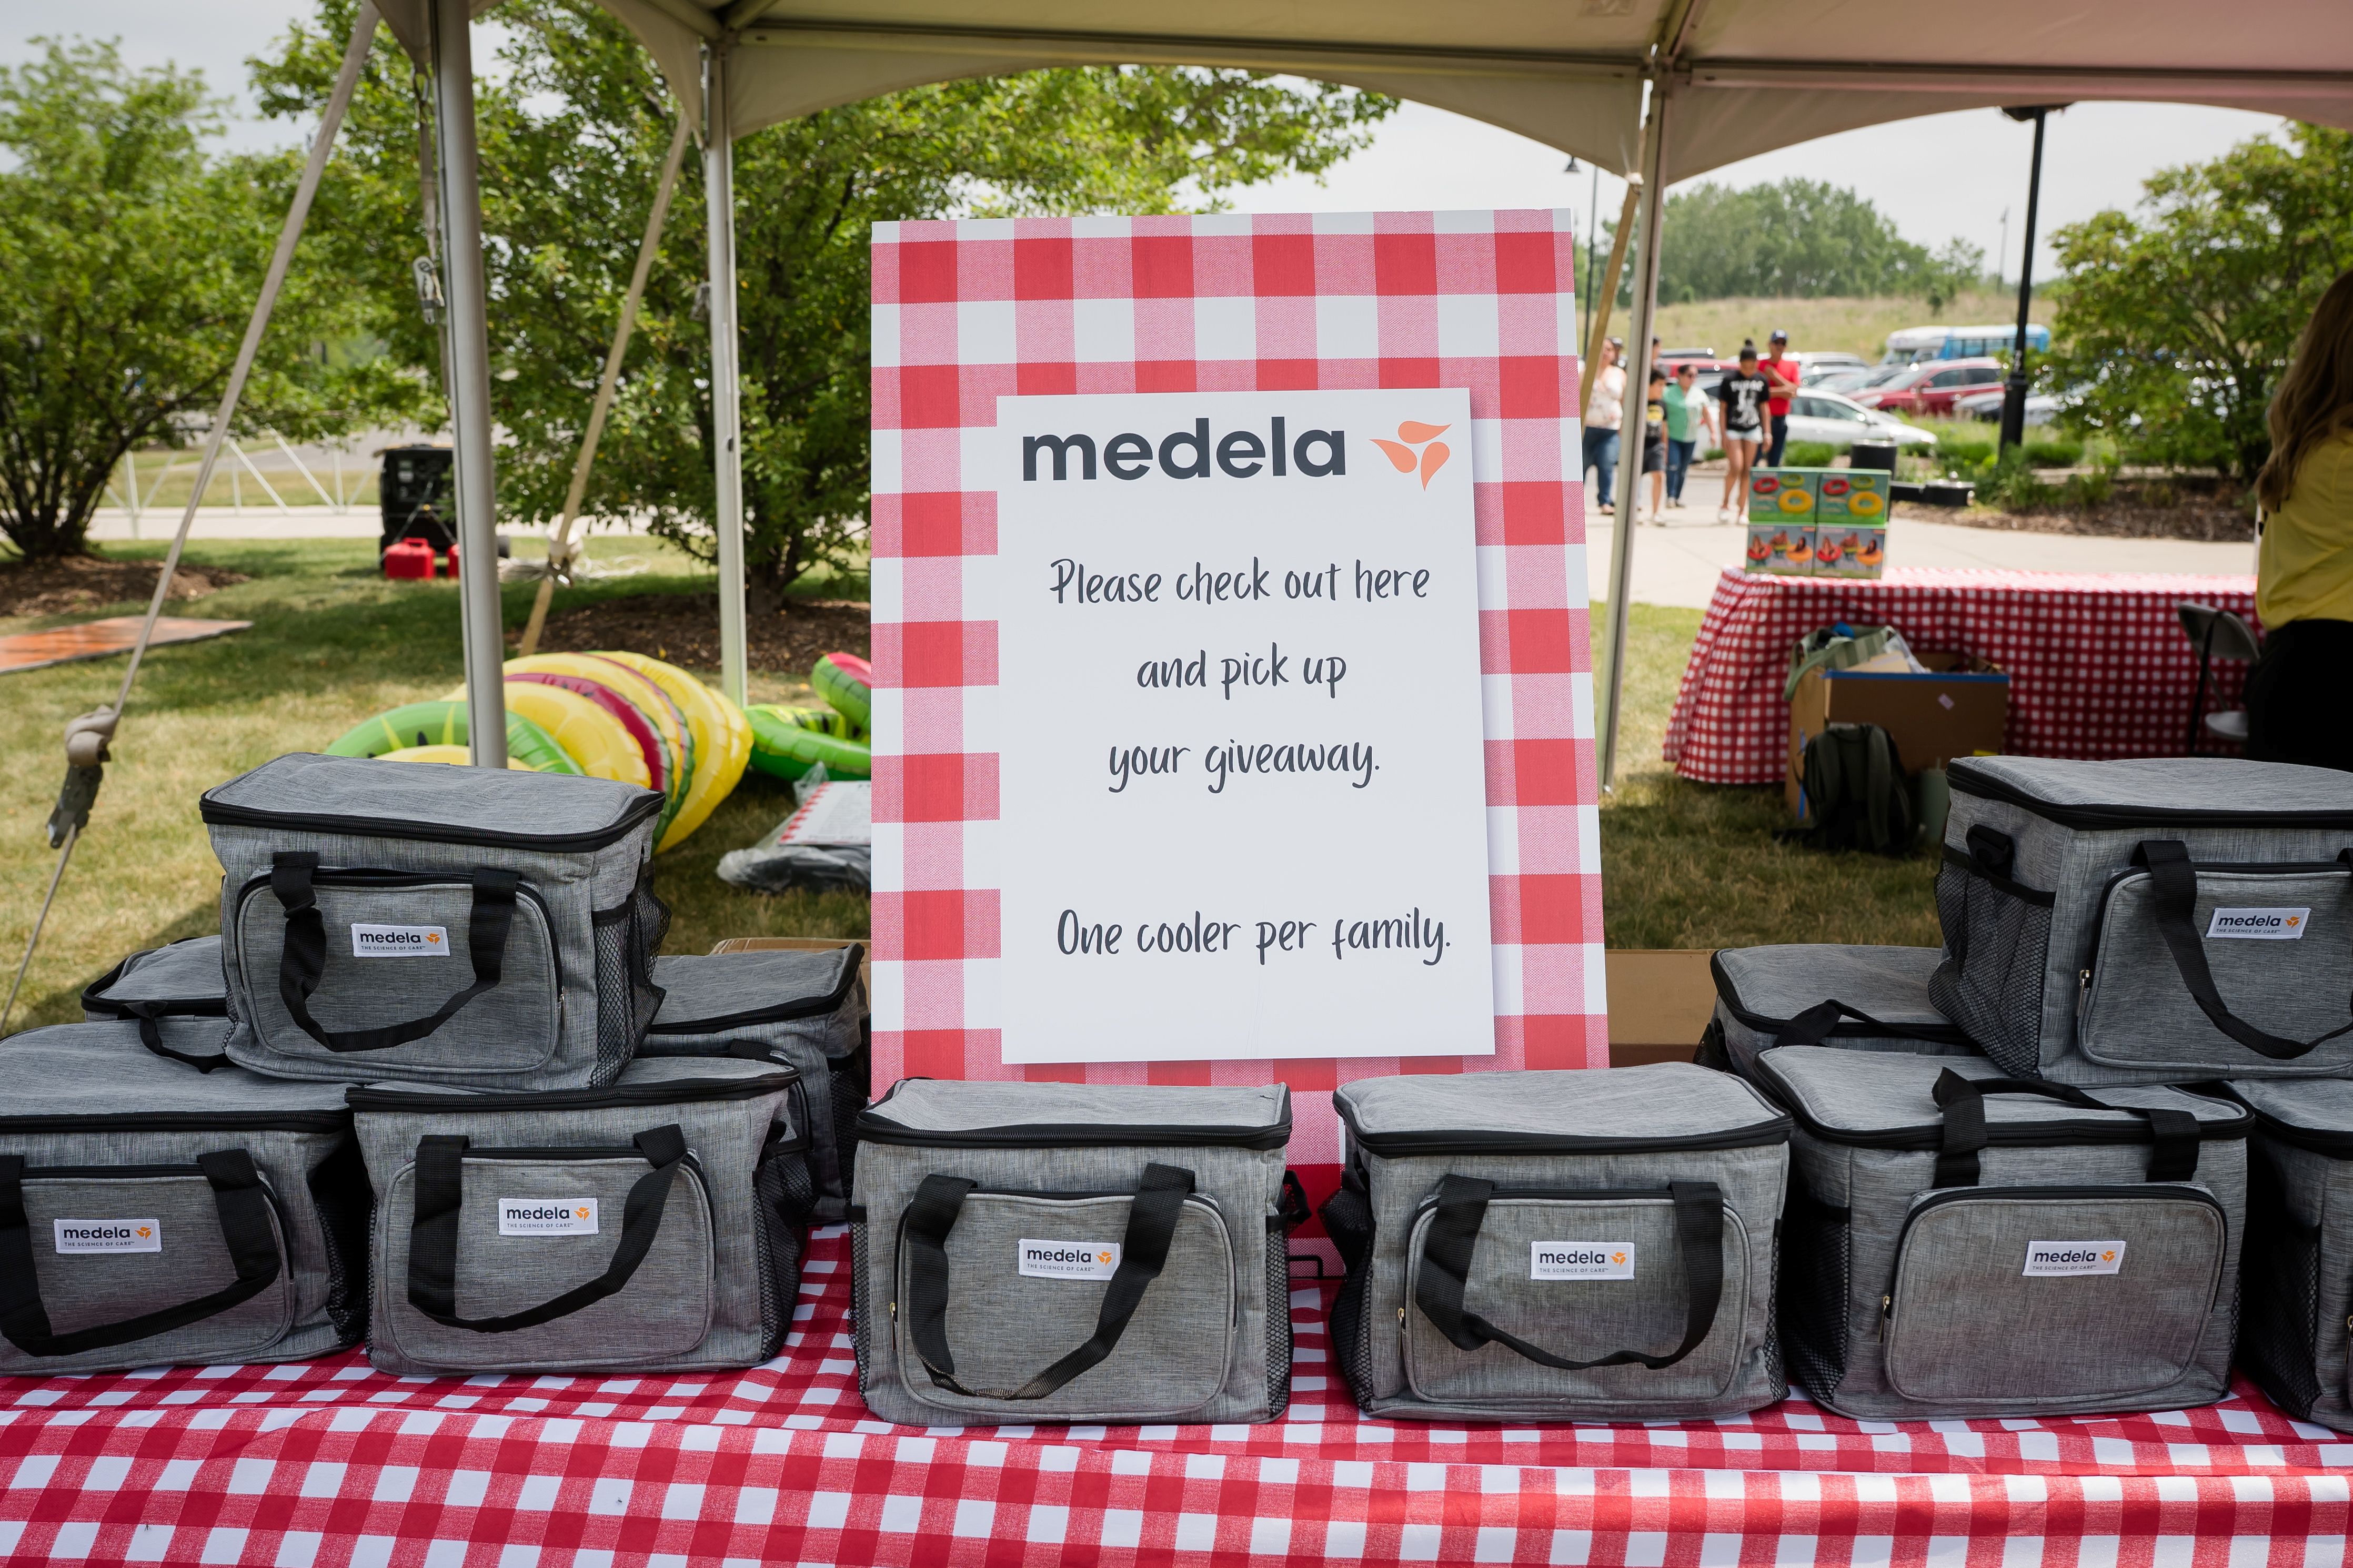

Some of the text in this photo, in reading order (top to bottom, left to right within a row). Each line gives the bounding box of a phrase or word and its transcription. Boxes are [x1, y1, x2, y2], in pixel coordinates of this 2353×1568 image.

[1023, 417, 1345, 481] medela
[1050, 557, 1429, 604] Please check out here
[1138, 642, 1346, 700] and pick up
[1109, 739, 1379, 793] your giveaway.
[2218, 915, 2281, 926] medela
[360, 932, 421, 943] medela
[1058, 907, 1450, 965] One cooler per family.
[507, 1207, 569, 1219] medela
[64, 1227, 130, 1238] medela
[1028, 1249, 1091, 1262] medela
[1540, 1251, 1605, 1264] medela
[2034, 1250, 2096, 1262] medela
